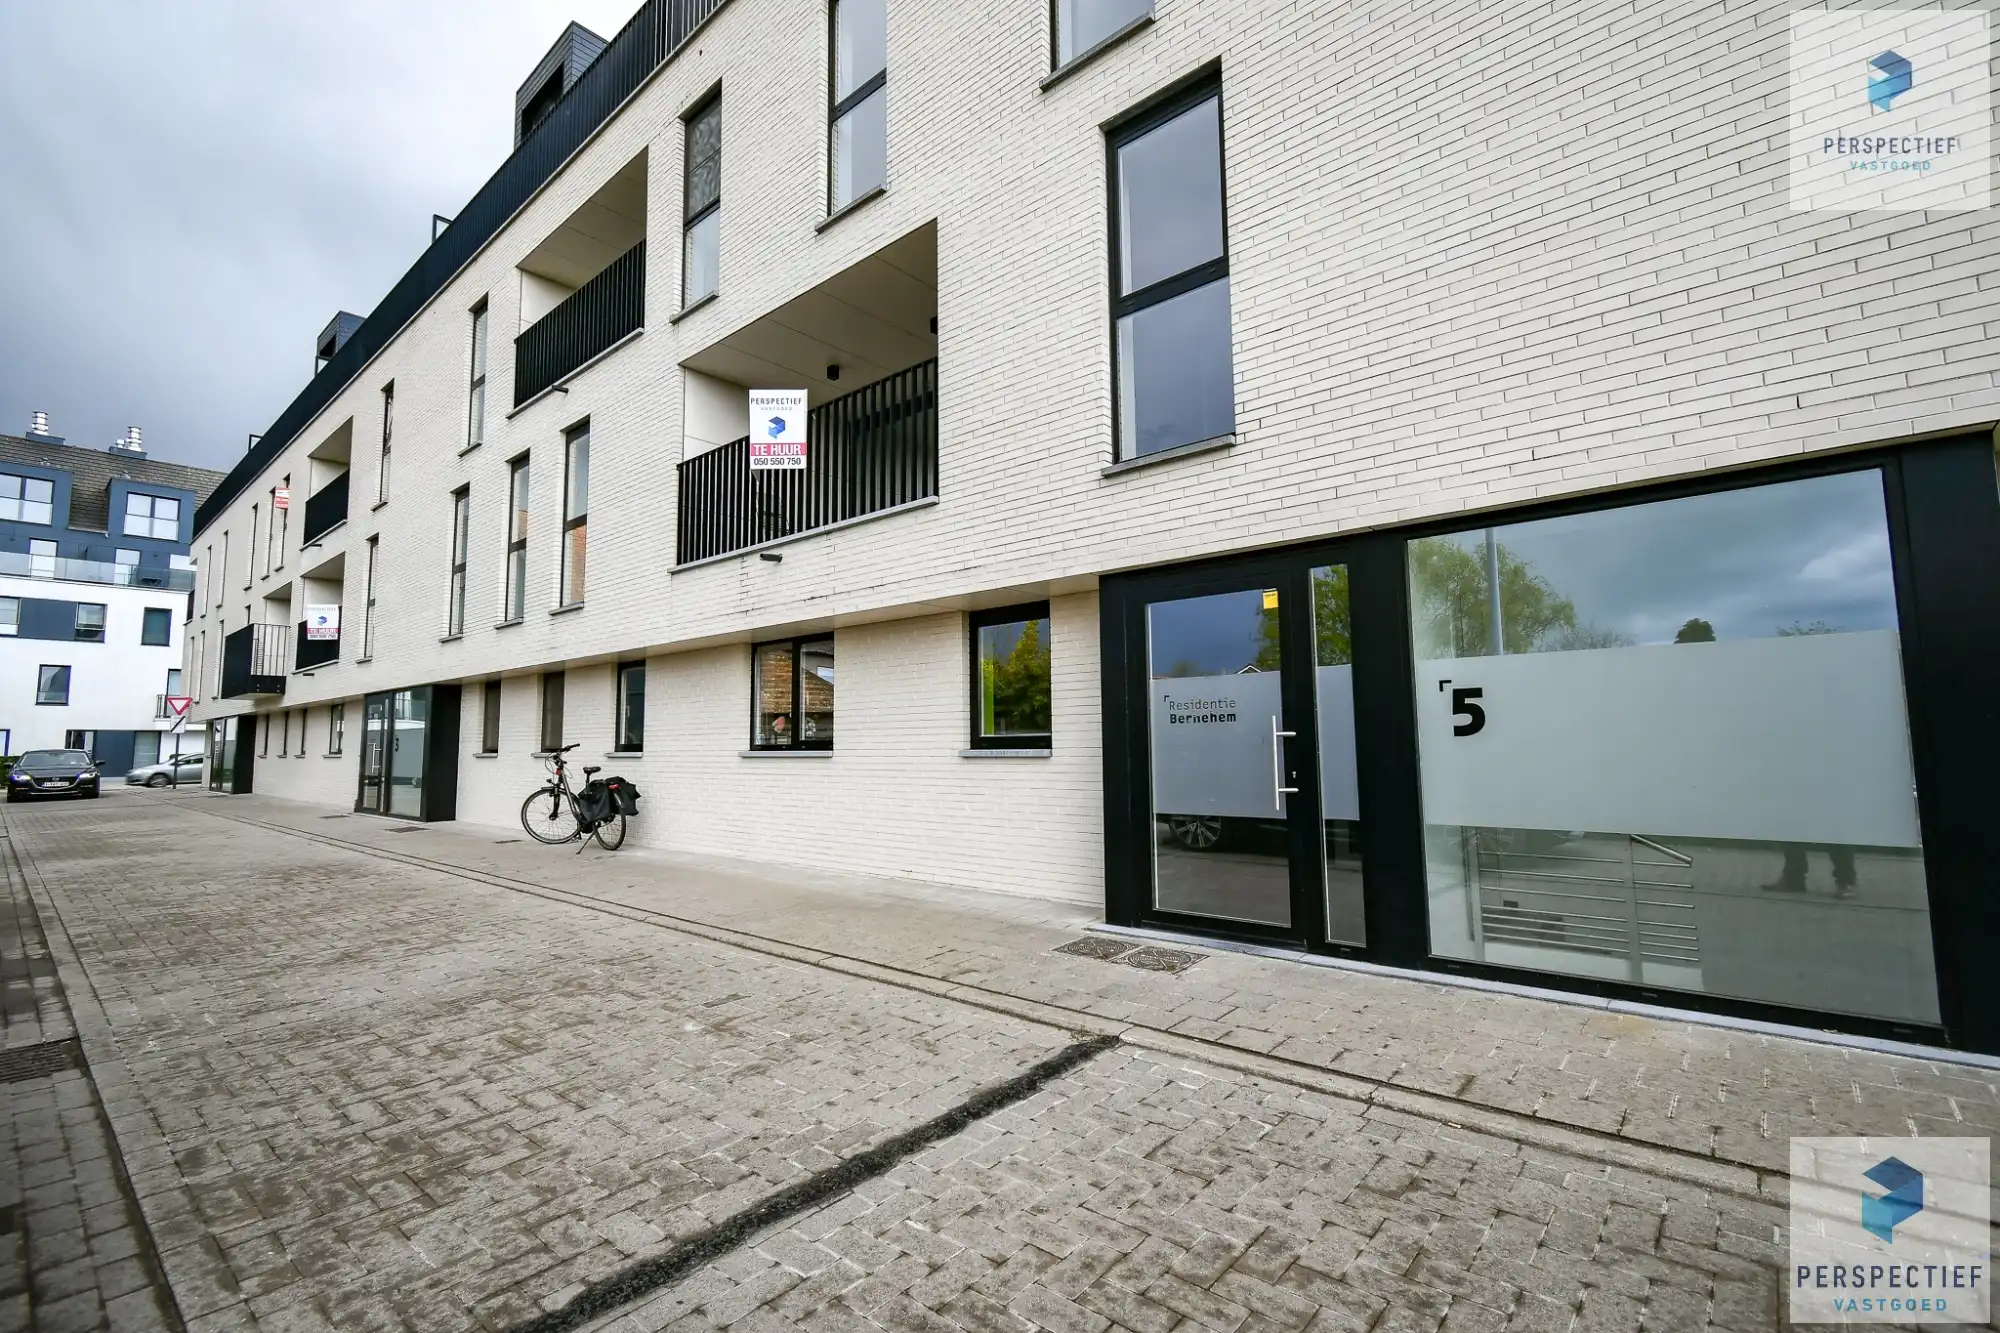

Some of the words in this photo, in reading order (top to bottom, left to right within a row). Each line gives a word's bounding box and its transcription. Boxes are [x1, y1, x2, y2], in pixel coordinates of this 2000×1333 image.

[750, 397, 803, 405] PERSPECTIEF
[754, 444, 768, 455] TE
[770, 443, 801, 455] HUUR
[753, 457, 768, 466] 050
[770, 457, 785, 466] 550
[787, 457, 801, 466] 750
[1169, 698, 1236, 711] Residentie
[1169, 711, 1237, 724] Bernehem
[1452, 687, 1486, 737] 5
